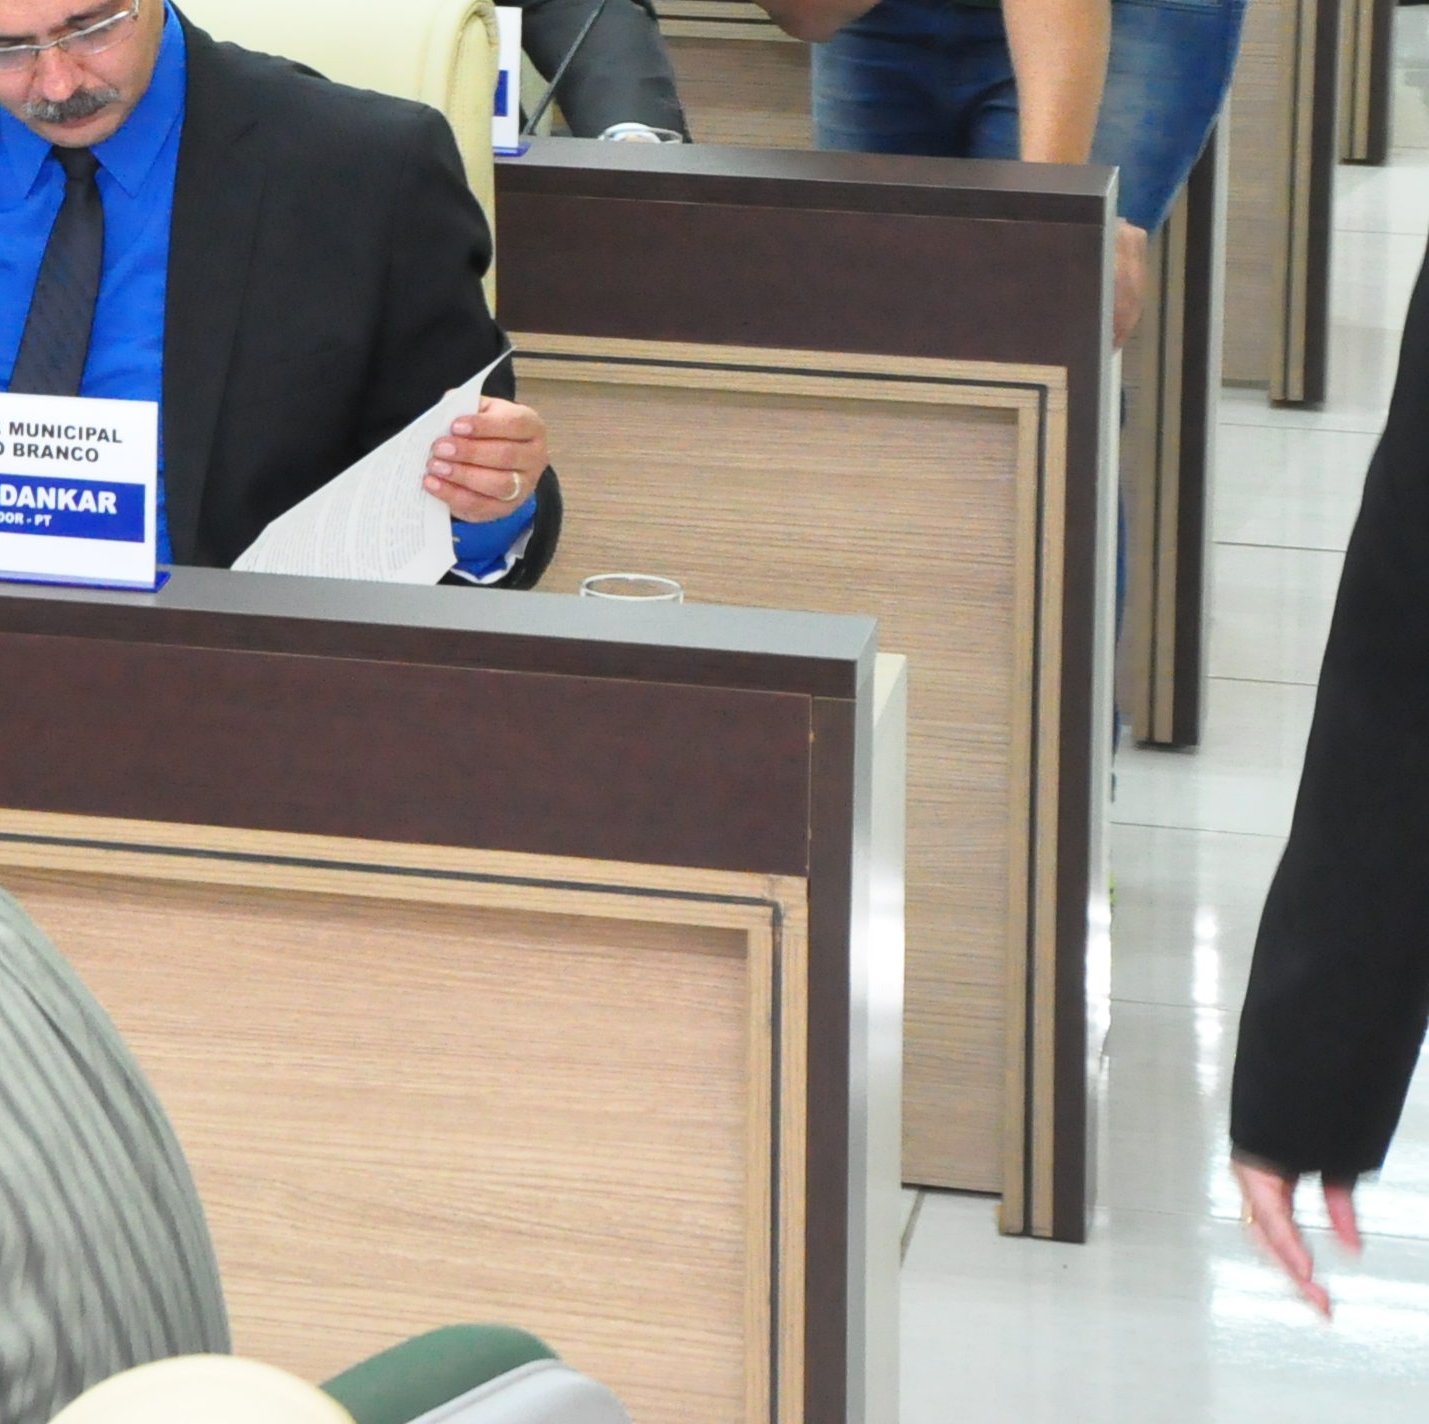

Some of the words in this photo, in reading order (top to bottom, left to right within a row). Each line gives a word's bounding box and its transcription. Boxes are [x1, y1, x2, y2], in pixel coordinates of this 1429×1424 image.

[8, 421, 124, 444] MUNICIPAL
[12, 442, 100, 463] BRANCO
[34, 513, 53, 528] PT
